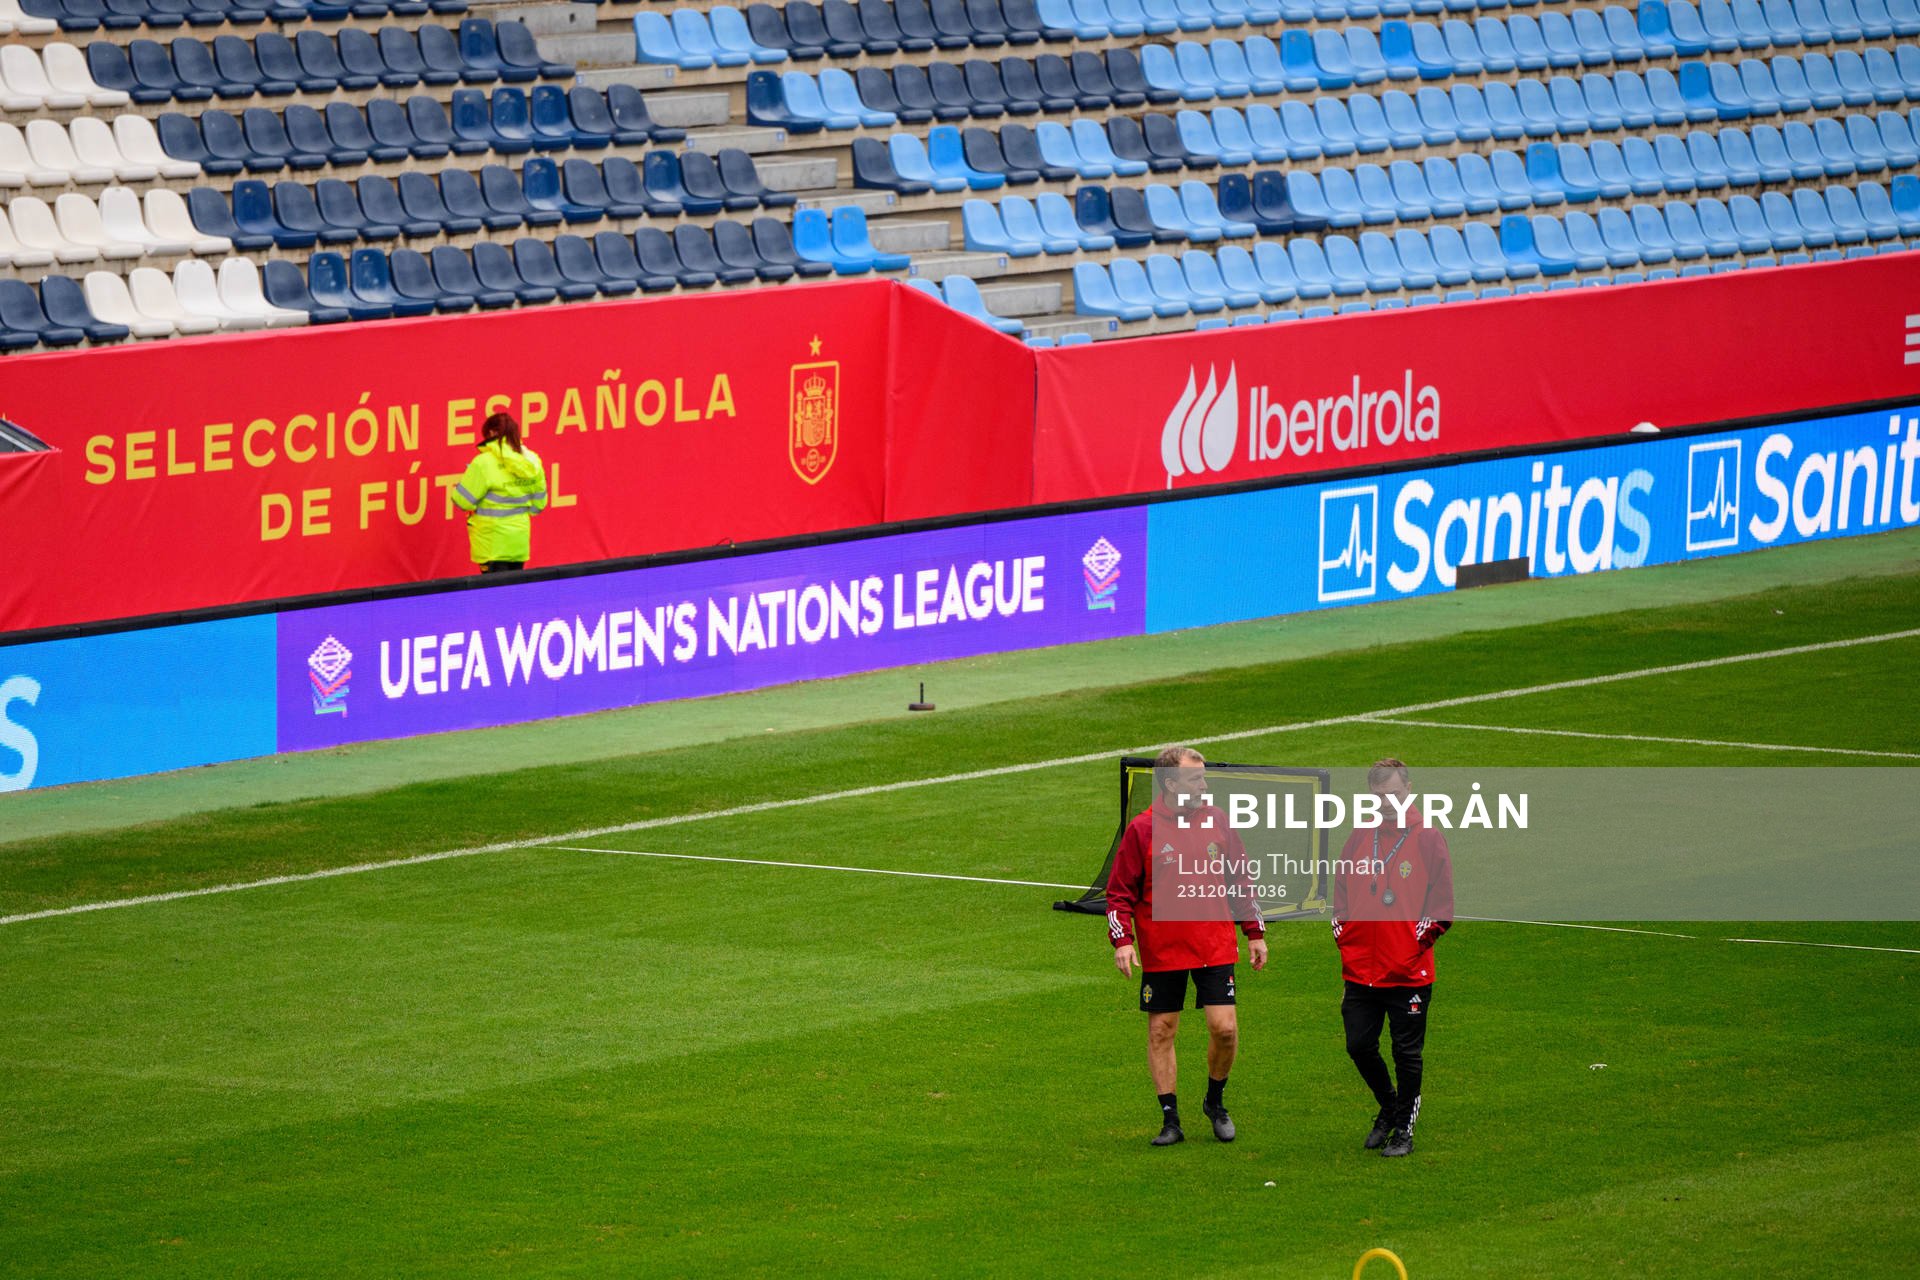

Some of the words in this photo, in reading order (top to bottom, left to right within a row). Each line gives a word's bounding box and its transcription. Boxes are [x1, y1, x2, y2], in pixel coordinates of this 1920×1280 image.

[85, 391, 420, 485] SELECCIÓN
[1249, 369, 1441, 461] Iberdrola
[261, 487, 332, 541] DE
[359, 461, 578, 530] FÚTL
[1385, 460, 1655, 594] Sanitas
[380, 631, 491, 699] UEFA
[494, 602, 698, 687] WOMEN'S
[707, 574, 884, 657] NATIONS
[894, 555, 1046, 630] LEAGUE
